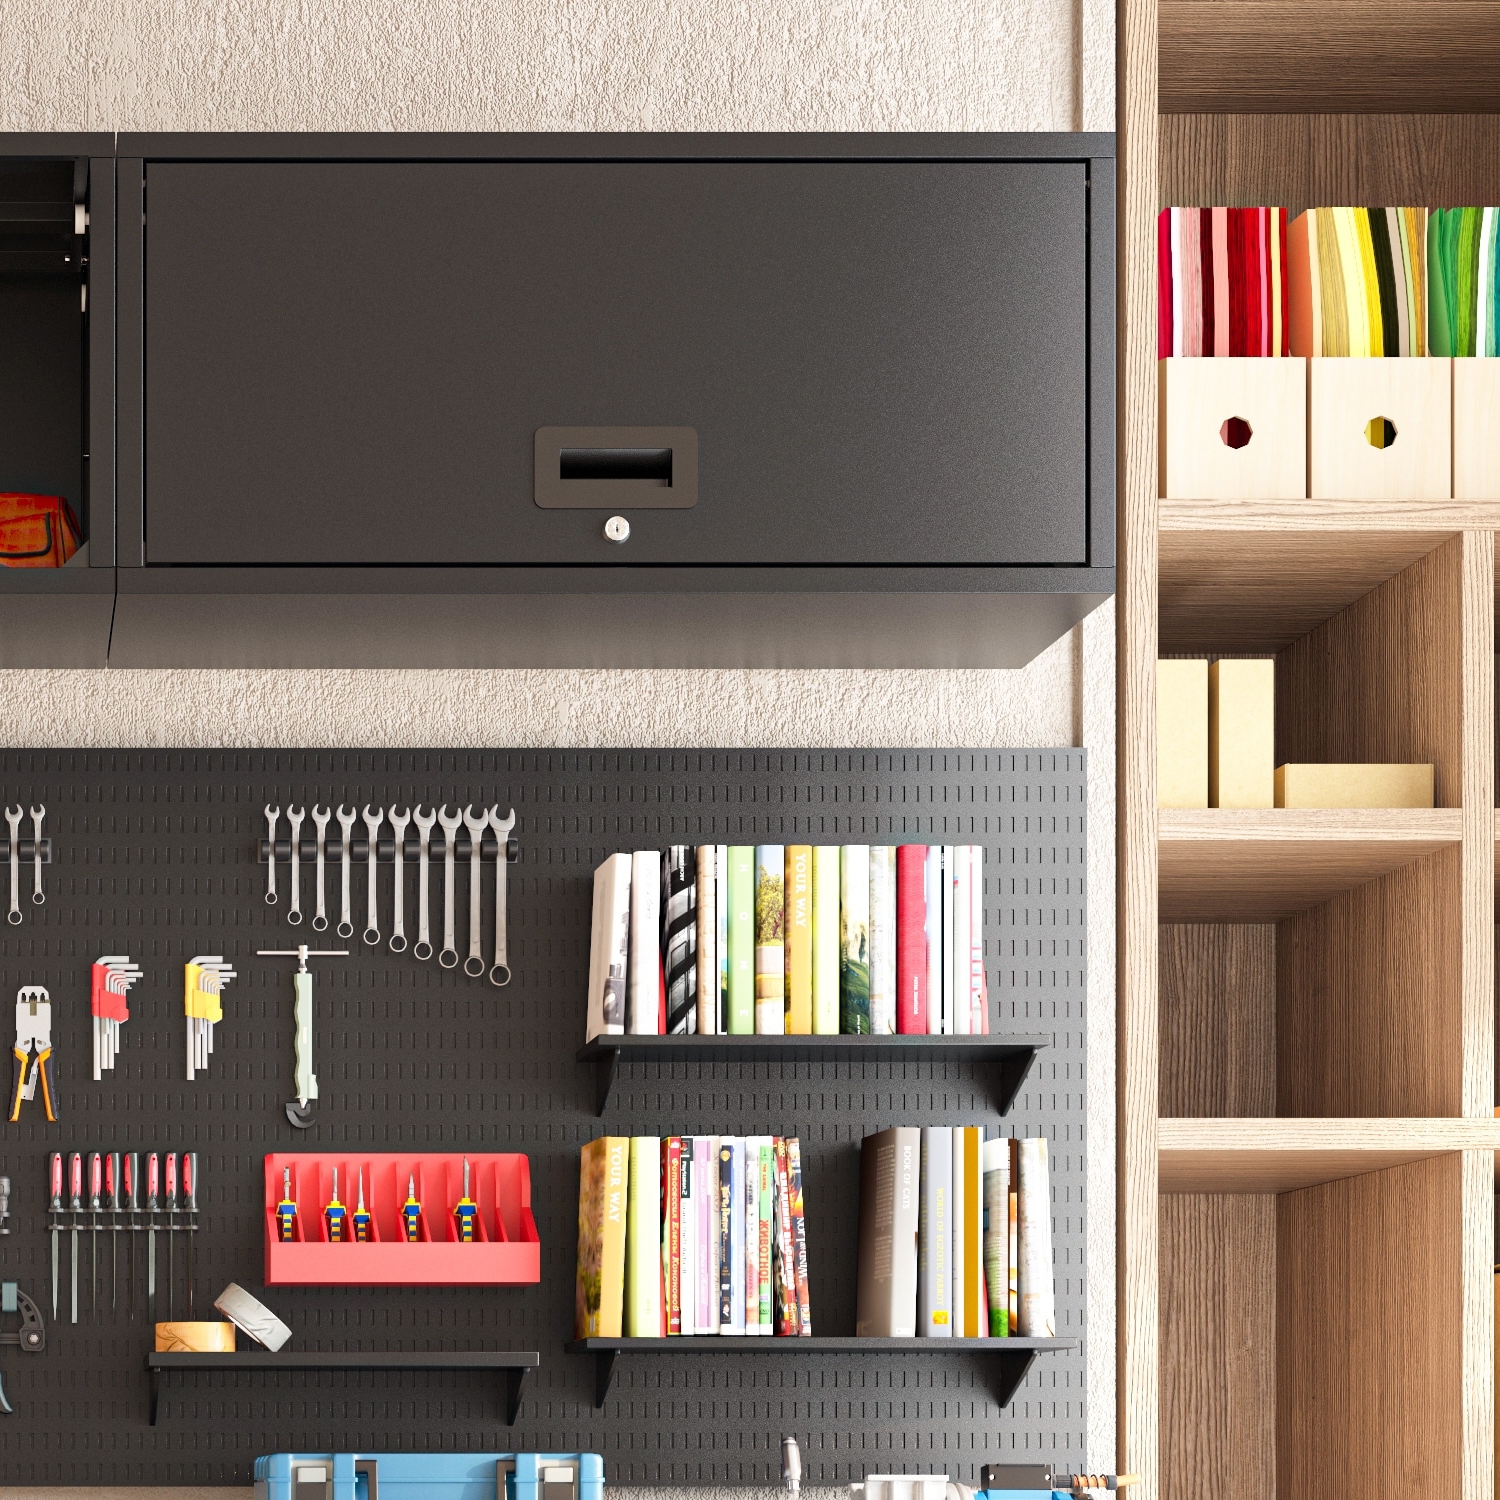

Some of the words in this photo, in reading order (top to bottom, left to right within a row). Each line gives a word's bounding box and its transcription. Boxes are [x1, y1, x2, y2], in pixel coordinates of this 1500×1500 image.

[795, 853, 807, 894] YOUR
[795, 897, 807, 928] WAY
[610, 1145, 622, 1187] YOUR
[903, 1145, 912, 1171] BOOK
[903, 1173, 911, 1185] OF
[609, 1190, 621, 1223] WAY
[902, 1187, 911, 1210] CATS
[936, 1187, 944, 1218] WORLD
[936, 1220, 944, 1232] OF
[759, 1219, 769, 1285] ЖИВОТНОЕ
[936, 1273, 944, 1306] PARROT
